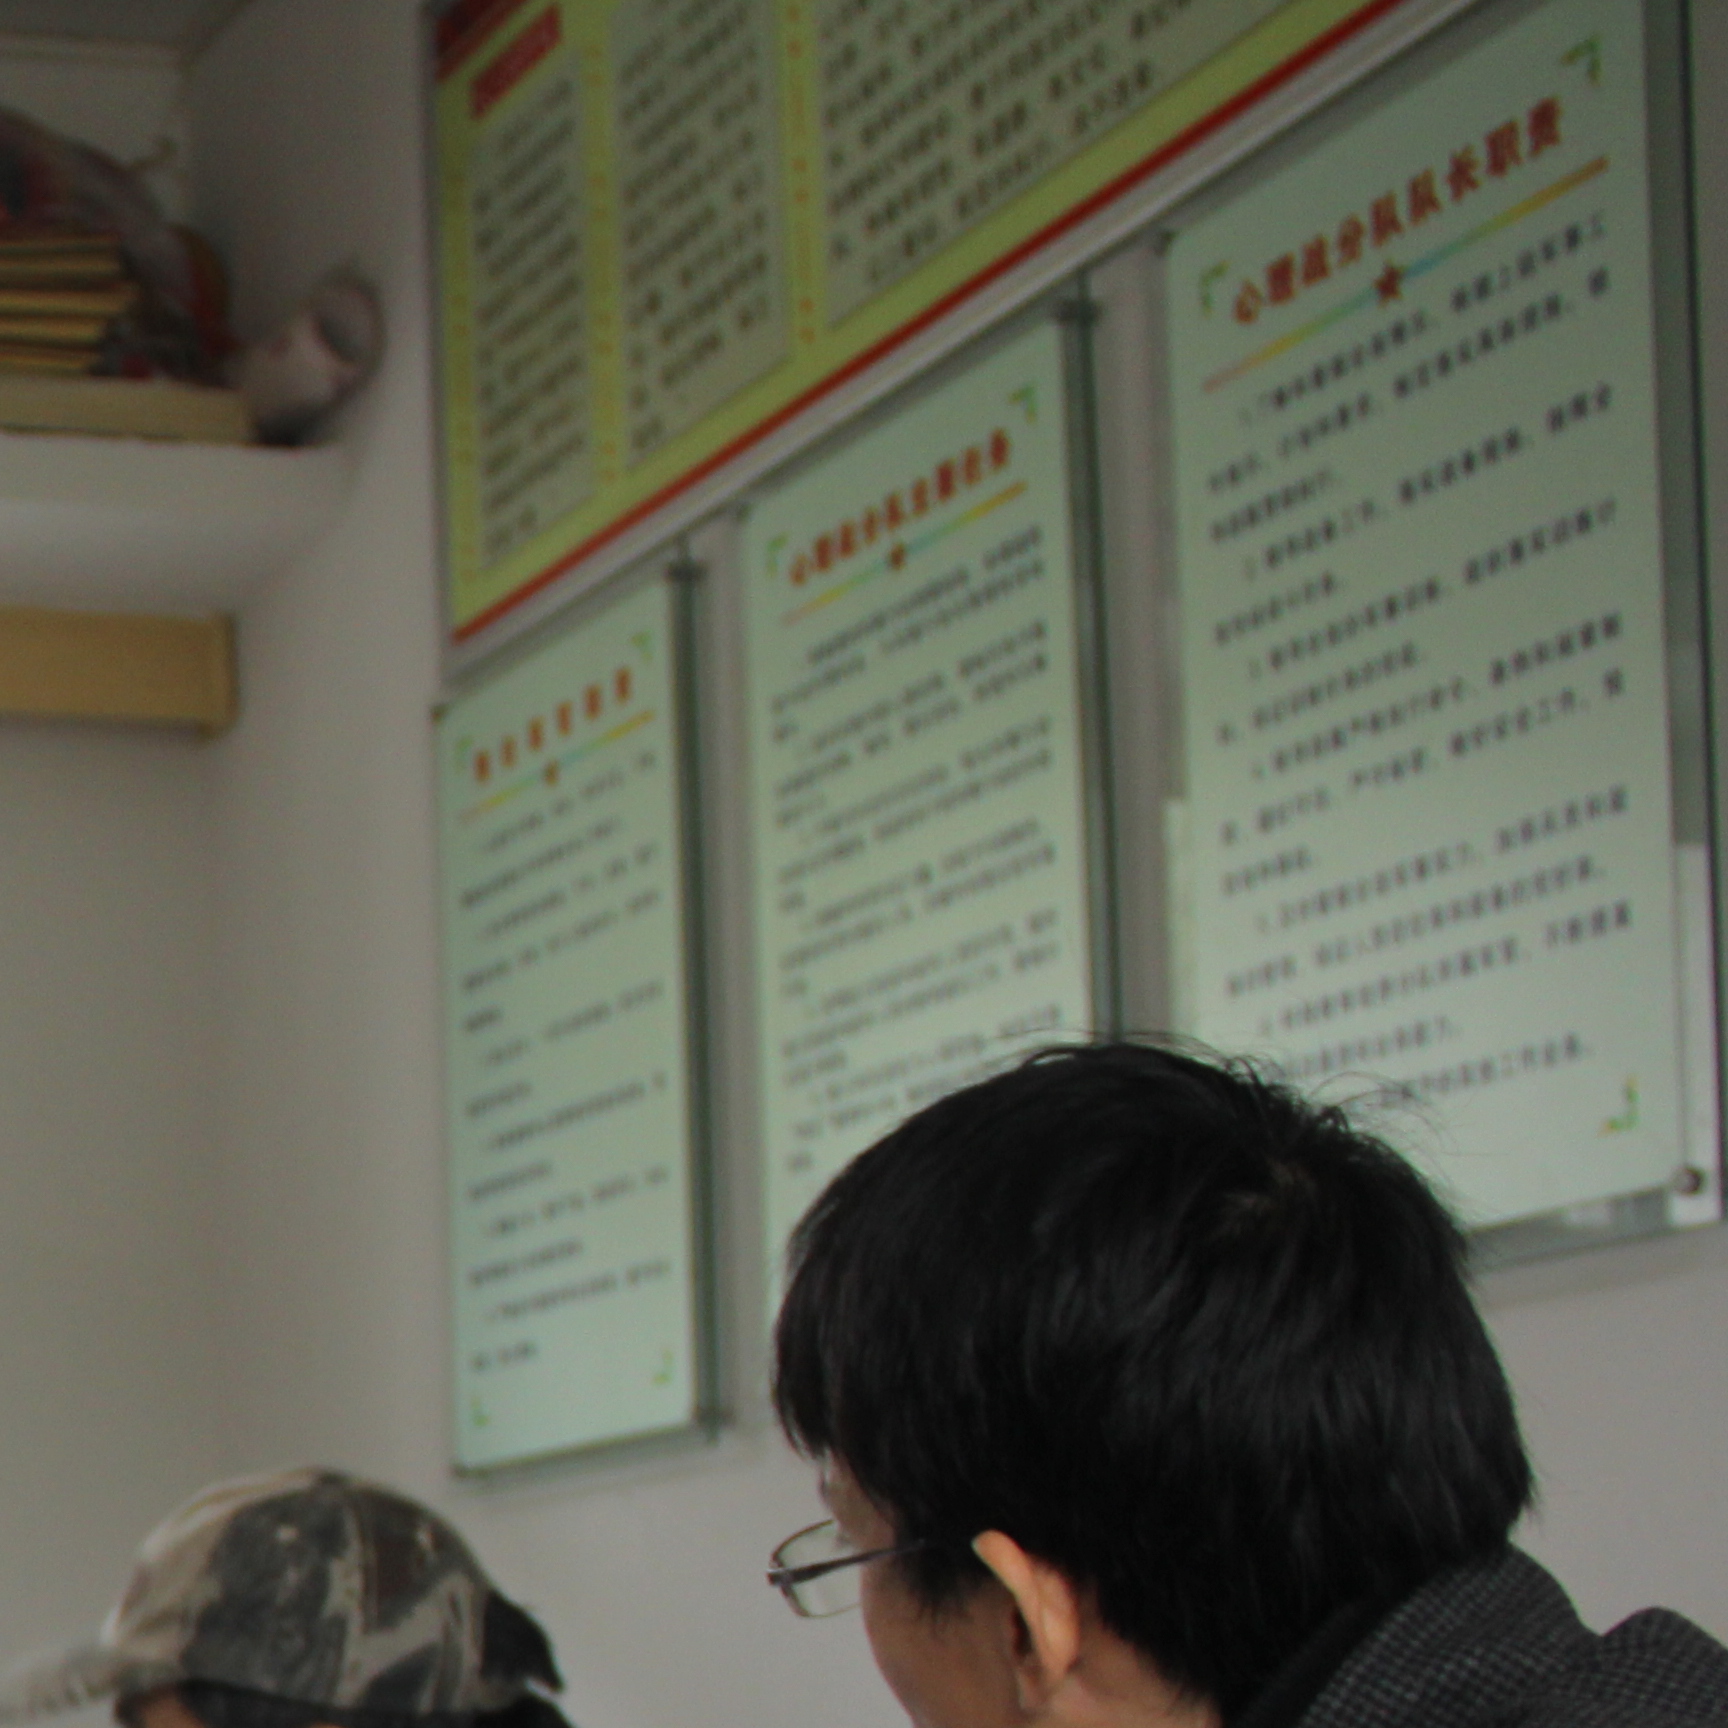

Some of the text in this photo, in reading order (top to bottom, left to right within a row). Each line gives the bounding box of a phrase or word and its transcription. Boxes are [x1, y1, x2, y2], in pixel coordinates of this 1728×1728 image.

[1232, 96, 1564, 327] 心理战分队队长职责
